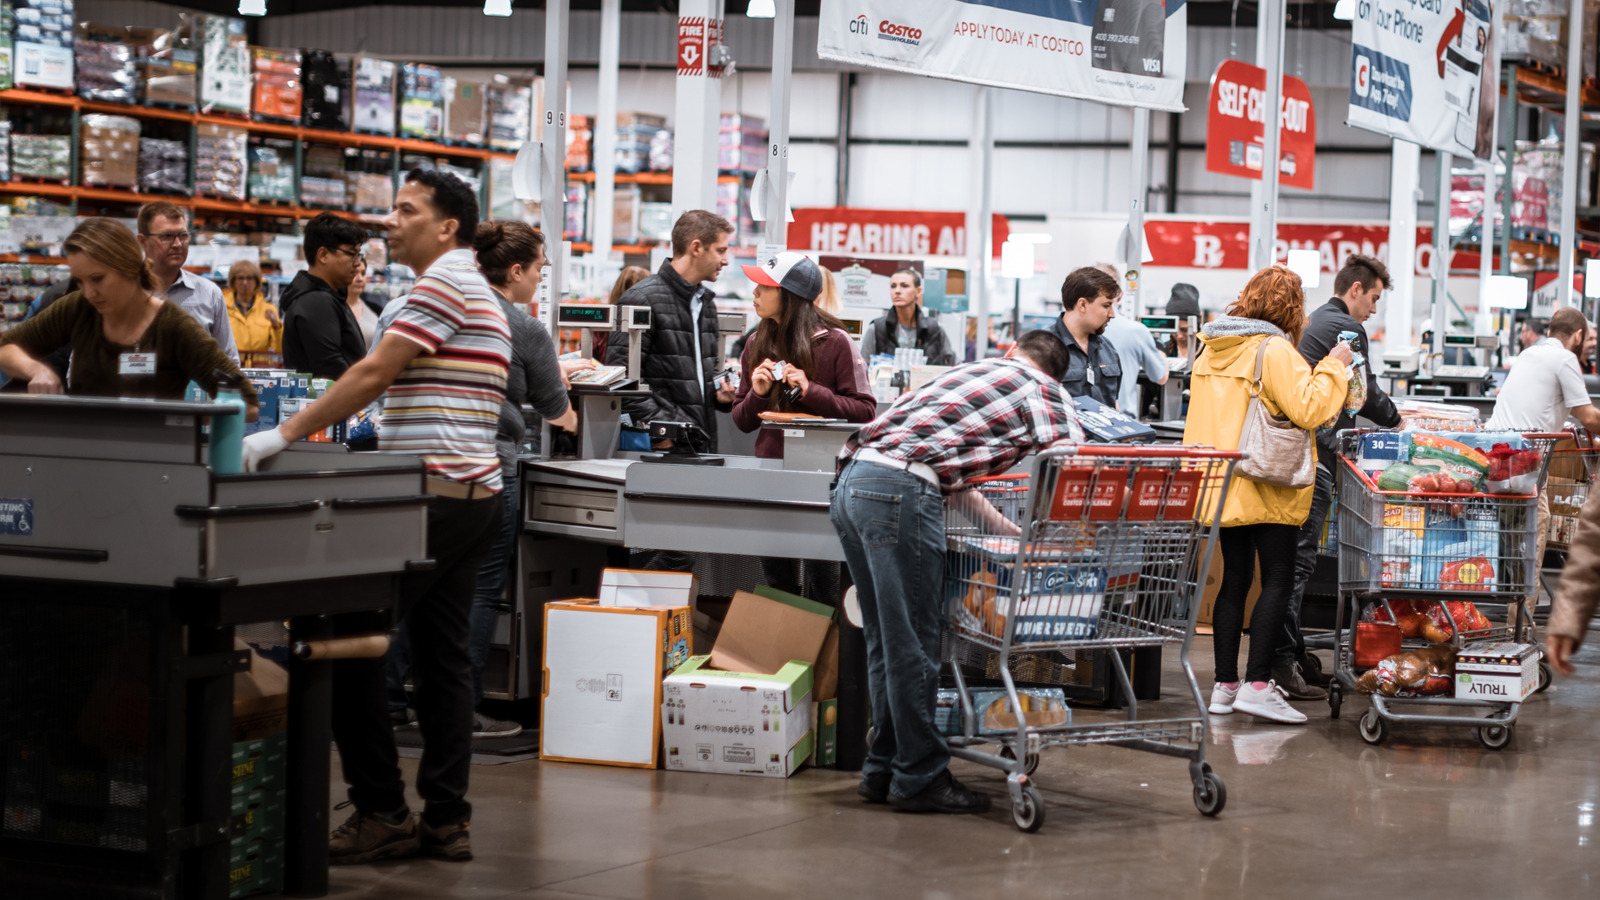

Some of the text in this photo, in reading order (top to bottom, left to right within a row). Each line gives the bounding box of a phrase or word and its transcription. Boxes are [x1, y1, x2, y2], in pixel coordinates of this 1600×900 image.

[680, 26, 703, 36] FIRE
[850, 17, 869, 35] citi
[1394, 9, 1423, 43] Phone
[891, 36, 920, 46] WHOLESALE
[953, 21, 1084, 56] APPLY TODAY AT COSTCO
[1142, 58, 1161, 73] VISA
[1217, 80, 1247, 118] SELF
[547, 111, 553, 125] 9
[559, 112, 564, 126] 9
[772, 144, 778, 157] 8
[1132, 199, 1138, 209] 7
[811, 222, 931, 254] HEARING
[1372, 440, 1384, 450] 30
[1384, 507, 1401, 517] GLAD
[1467, 508, 1497, 516] GALLON
[1469, 683, 1508, 696] TRULY
